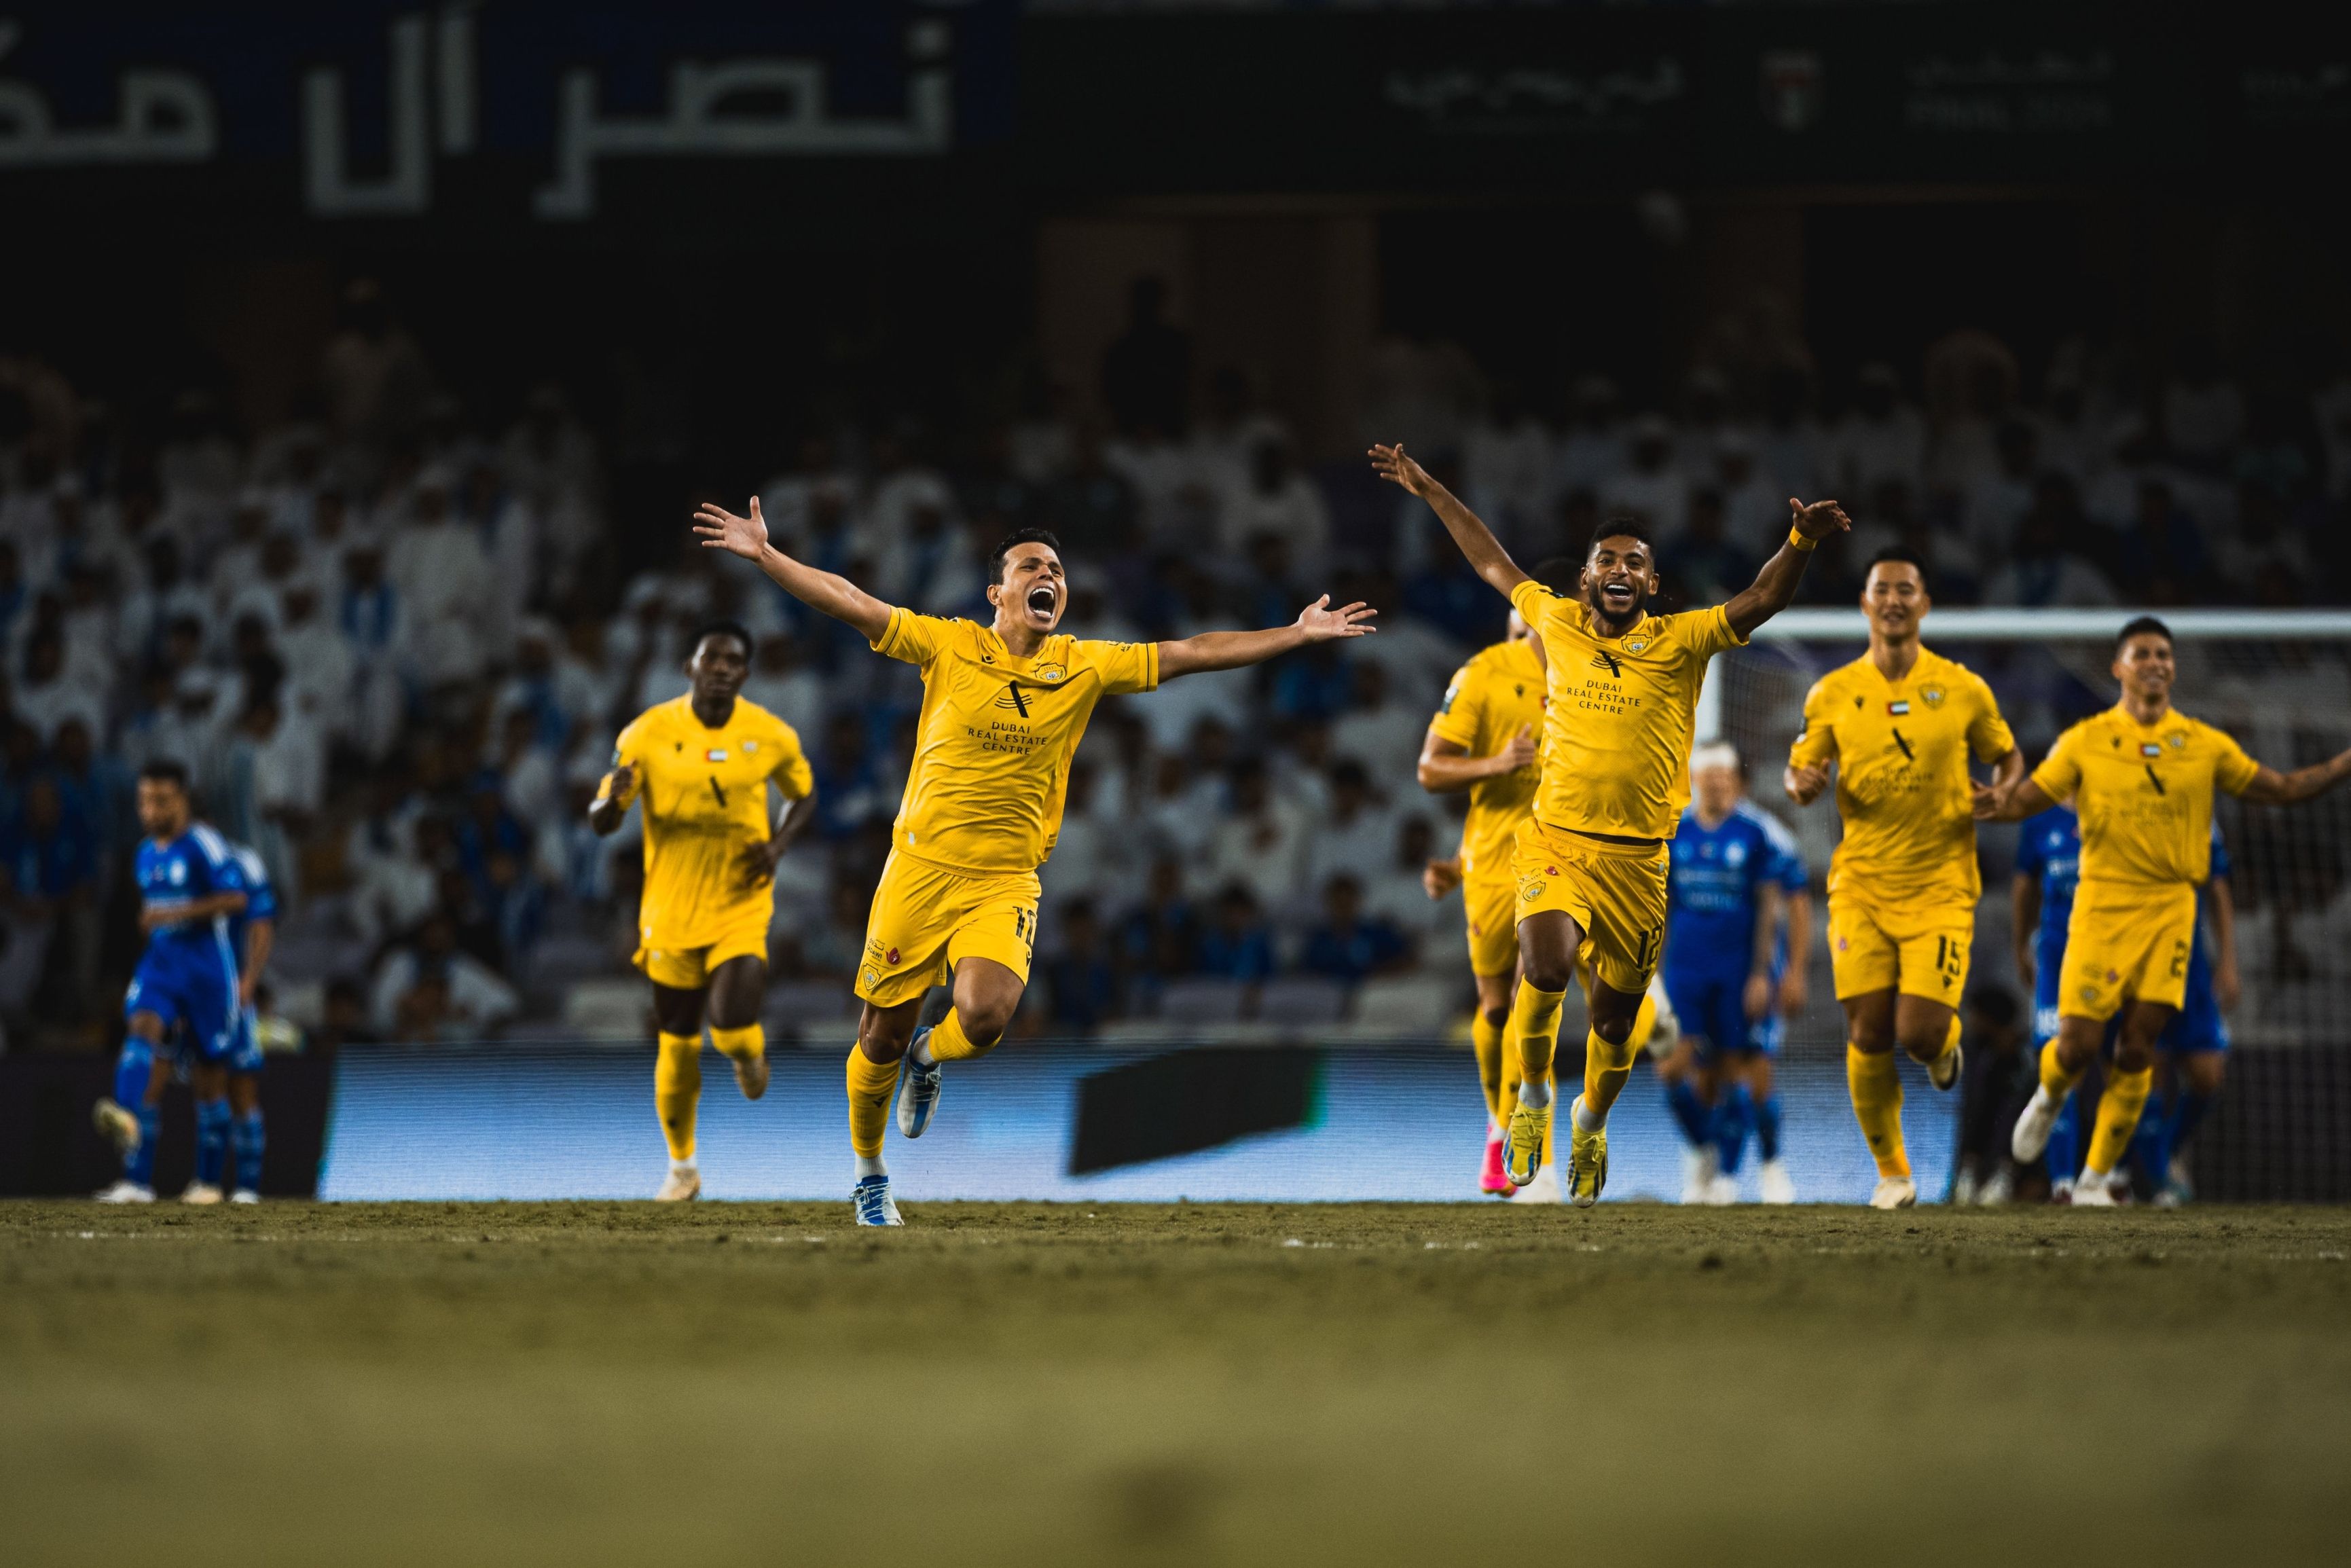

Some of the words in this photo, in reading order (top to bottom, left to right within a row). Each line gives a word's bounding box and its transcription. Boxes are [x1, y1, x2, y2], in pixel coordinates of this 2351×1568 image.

[1586, 680, 1622, 693] DUBAI
[1567, 687, 1592, 699] REAL
[1599, 692, 1641, 708] ESTATE
[1579, 700, 1624, 715] CENTRE
[991, 721, 1030, 734] DUBAI
[968, 728, 999, 741] REAL
[1005, 734, 1047, 746] ESTATE
[982, 742, 1031, 755] CENTRE
[1637, 926, 1663, 969] 12
[1937, 934, 1961, 976] 15
